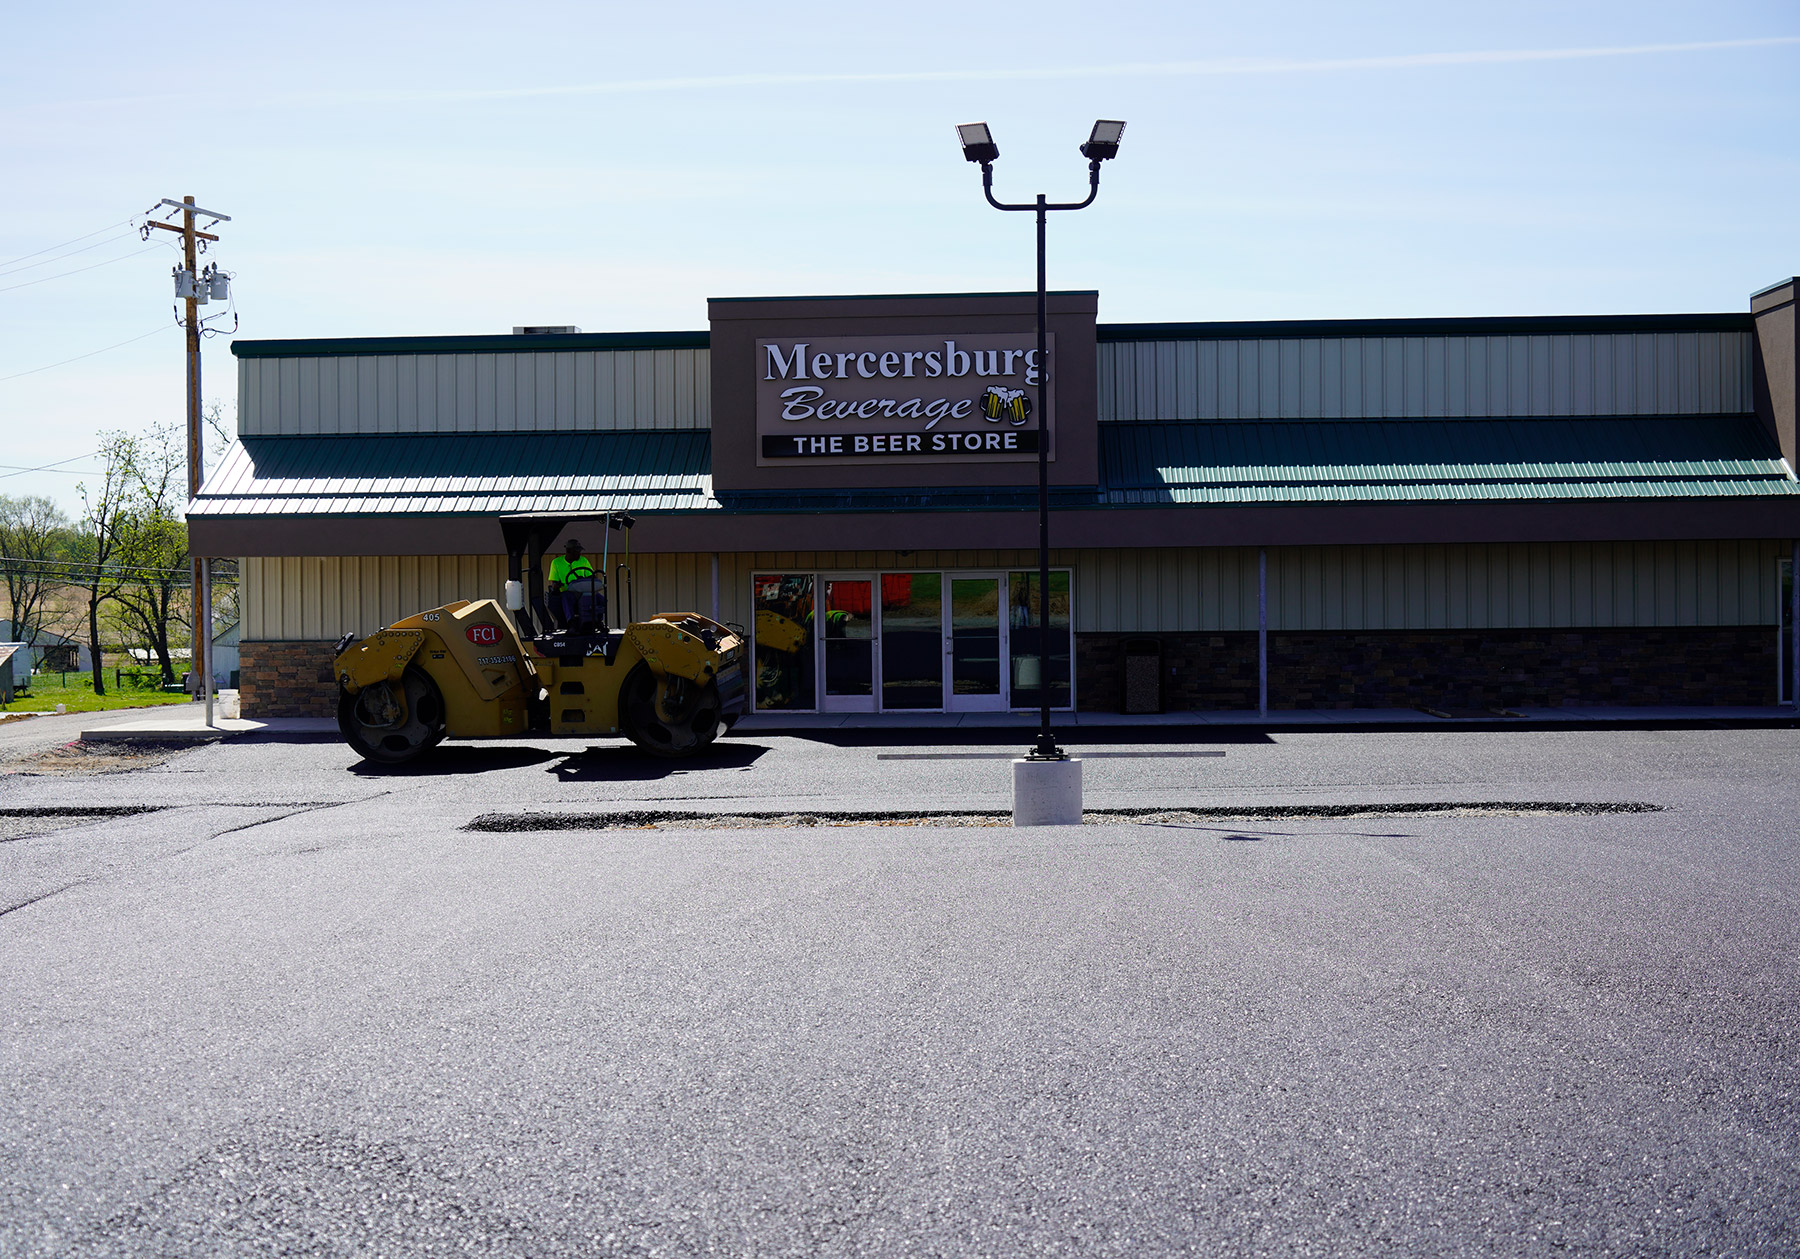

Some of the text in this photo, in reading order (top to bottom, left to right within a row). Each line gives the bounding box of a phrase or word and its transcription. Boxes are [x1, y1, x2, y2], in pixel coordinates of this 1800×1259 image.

[763, 340, 1049, 386] Mercersburg
[779, 385, 973, 431] Beverage
[793, 432, 1018, 454] THE BEER STORE
[423, 613, 440, 622] 405
[472, 627, 496, 642] FCI
